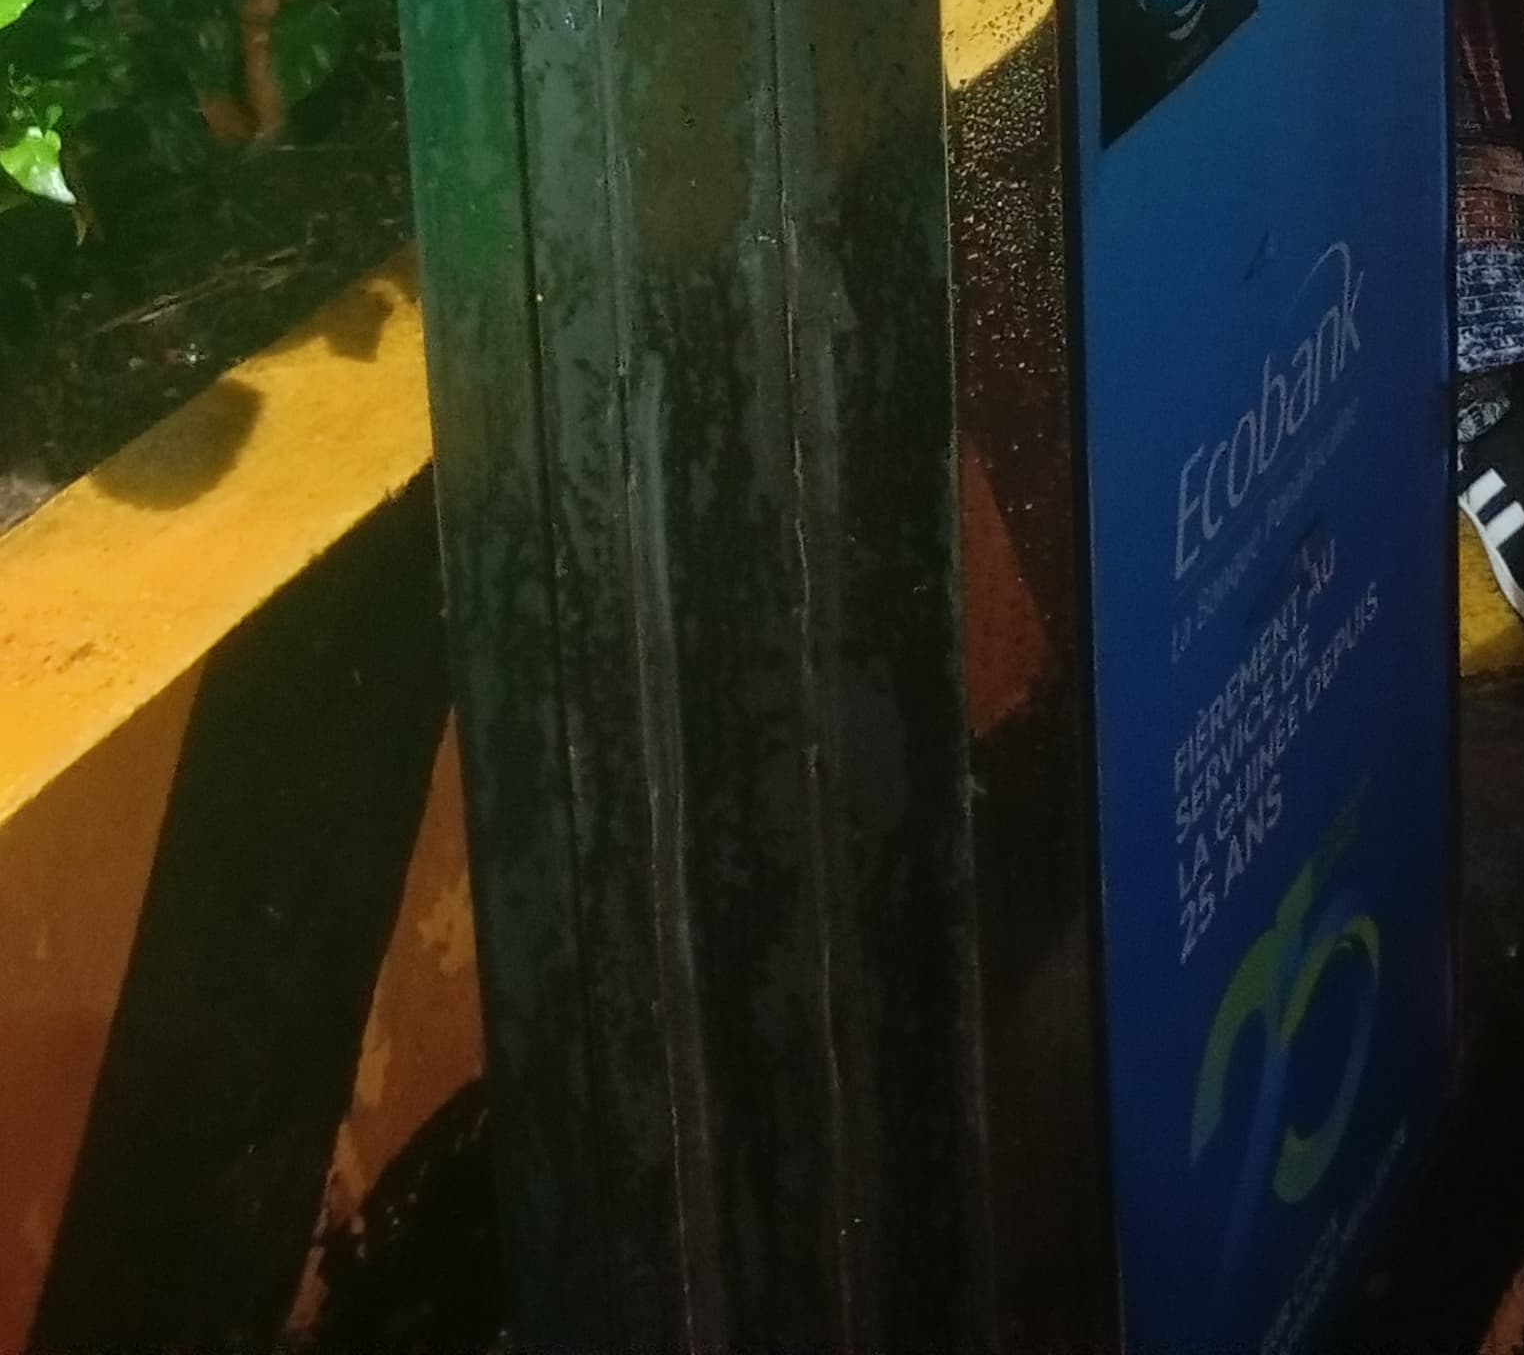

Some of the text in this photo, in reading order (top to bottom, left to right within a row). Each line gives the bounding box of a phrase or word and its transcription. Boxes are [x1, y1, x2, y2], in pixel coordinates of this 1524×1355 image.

[1174, 241, 1364, 579] Ecobank
[1175, 673, 1274, 843] SERVICE
[1280, 623, 1310, 694] DE
[1178, 834, 1210, 900] LA
[1305, 581, 1379, 712] DEPUIS
[1179, 773, 1282, 965] 25 ANS
